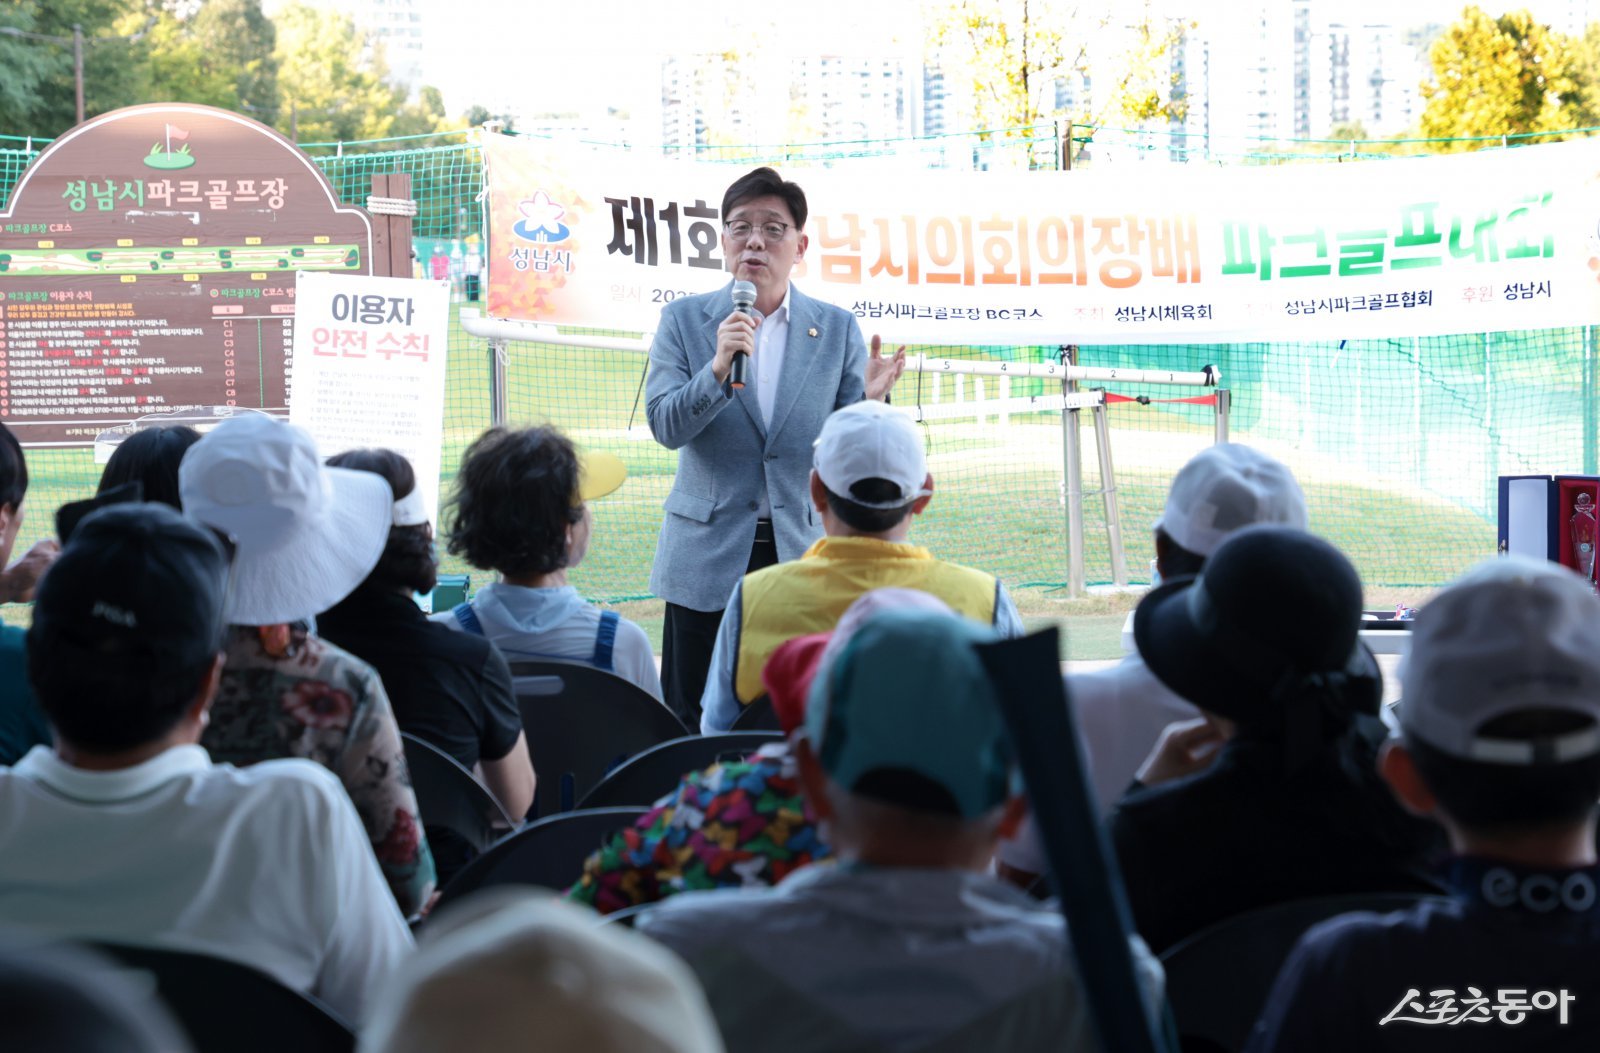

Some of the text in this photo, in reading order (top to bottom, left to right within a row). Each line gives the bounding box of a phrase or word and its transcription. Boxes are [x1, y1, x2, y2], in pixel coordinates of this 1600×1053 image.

[509, 247, 571, 272] 성남시
[790, 212, 1201, 288] 남시의회의장배
[331, 293, 415, 326] 이용자
[652, 288, 698, 303] 20
[852, 300, 980, 320] 성남시파크골프장
[986, 308, 1043, 321] BC코스
[1114, 304, 1213, 322] 성남시체육회
[1284, 289, 1433, 316] 성남시파크골프협회
[1461, 284, 1494, 304] 후원
[1503, 280, 1552, 301] 성남시
[312, 327, 430, 362] 안전 수칙
[944, 361, 950, 370] 5
[1000, 363, 1007, 372] 4
[1048, 365, 1055, 374] 3
[1111, 370, 1116, 378] 2
